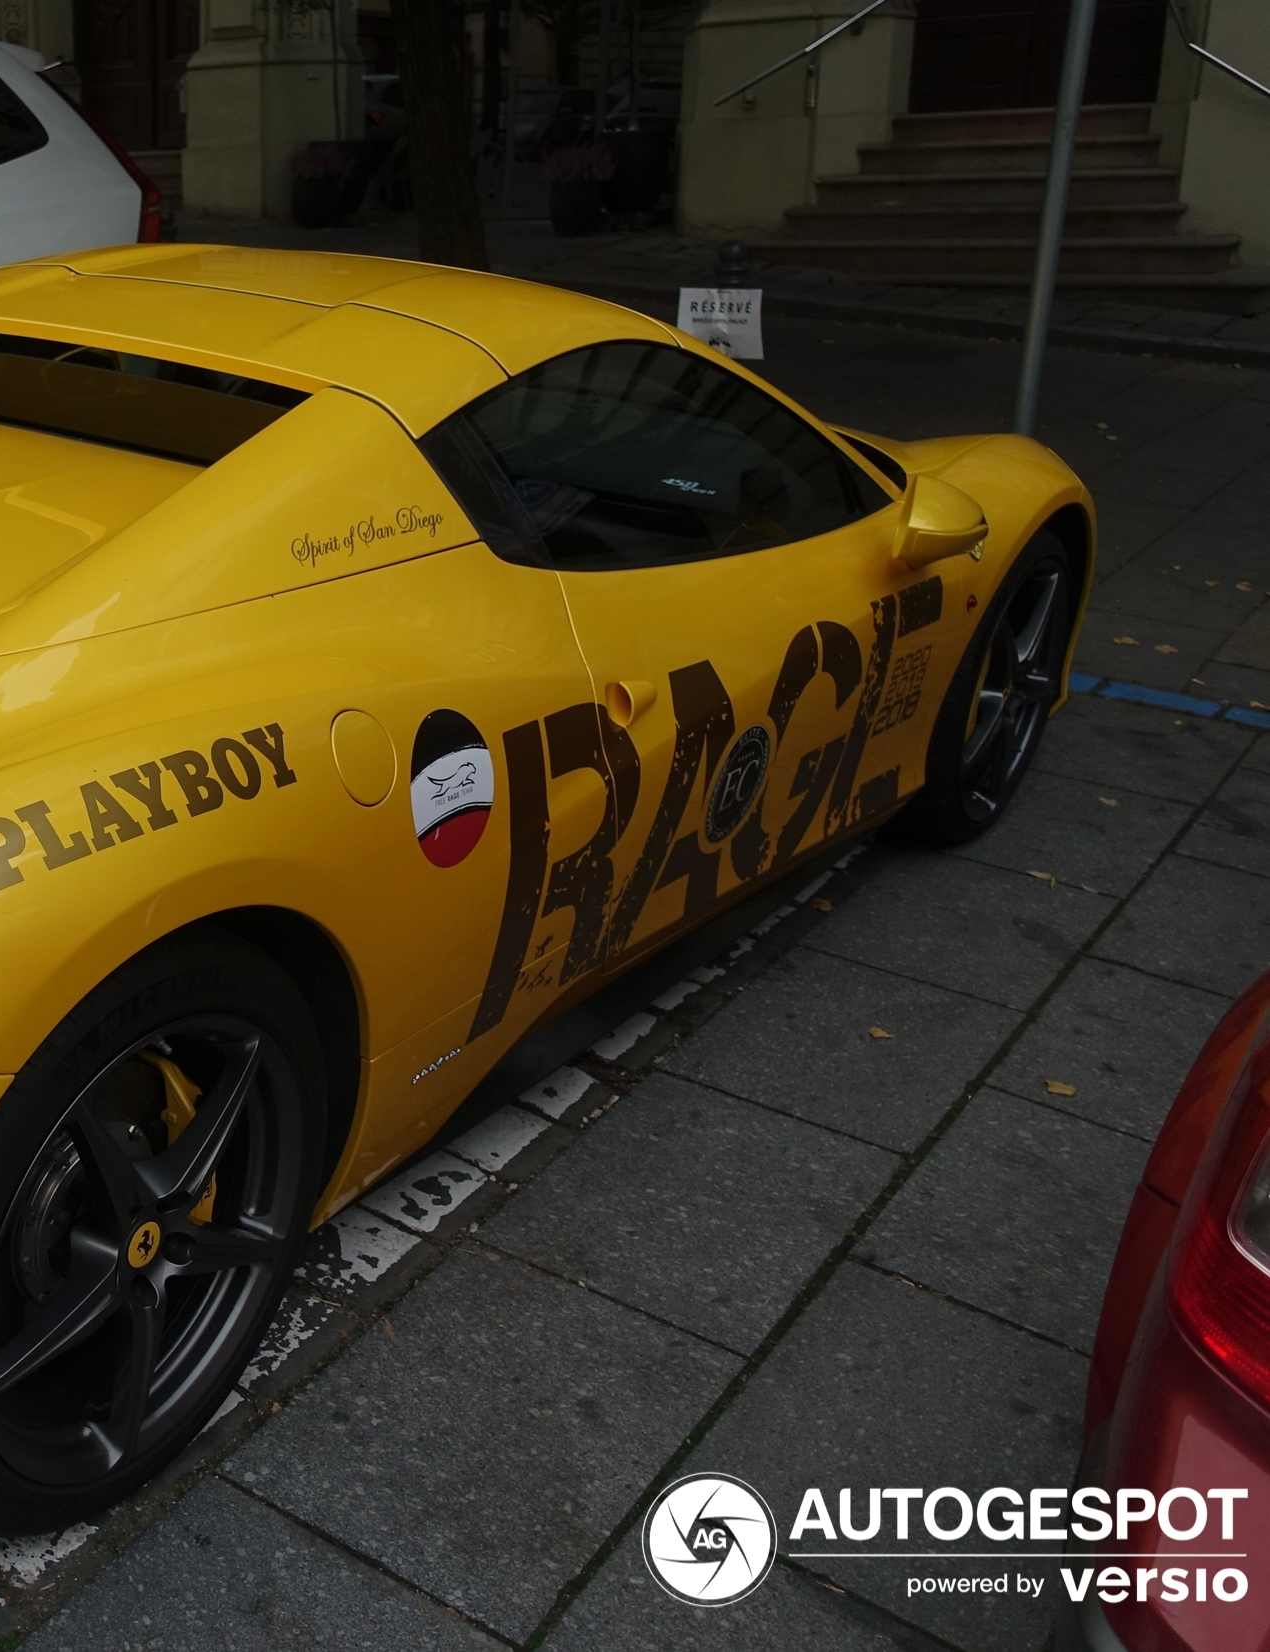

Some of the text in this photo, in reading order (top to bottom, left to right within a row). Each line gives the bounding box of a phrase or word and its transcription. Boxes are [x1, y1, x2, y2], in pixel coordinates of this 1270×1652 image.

[690, 299, 752, 314] RÉSERVÉ
[291, 505, 444, 567] Spirit of San Diego
[890, 644, 932, 681] 2020
[884, 667, 926, 704] 2019
[870, 688, 921, 738] 2018
[435, 786, 473, 807] FREE RAGE TEAM
[465, 576, 943, 1045] RAGE
